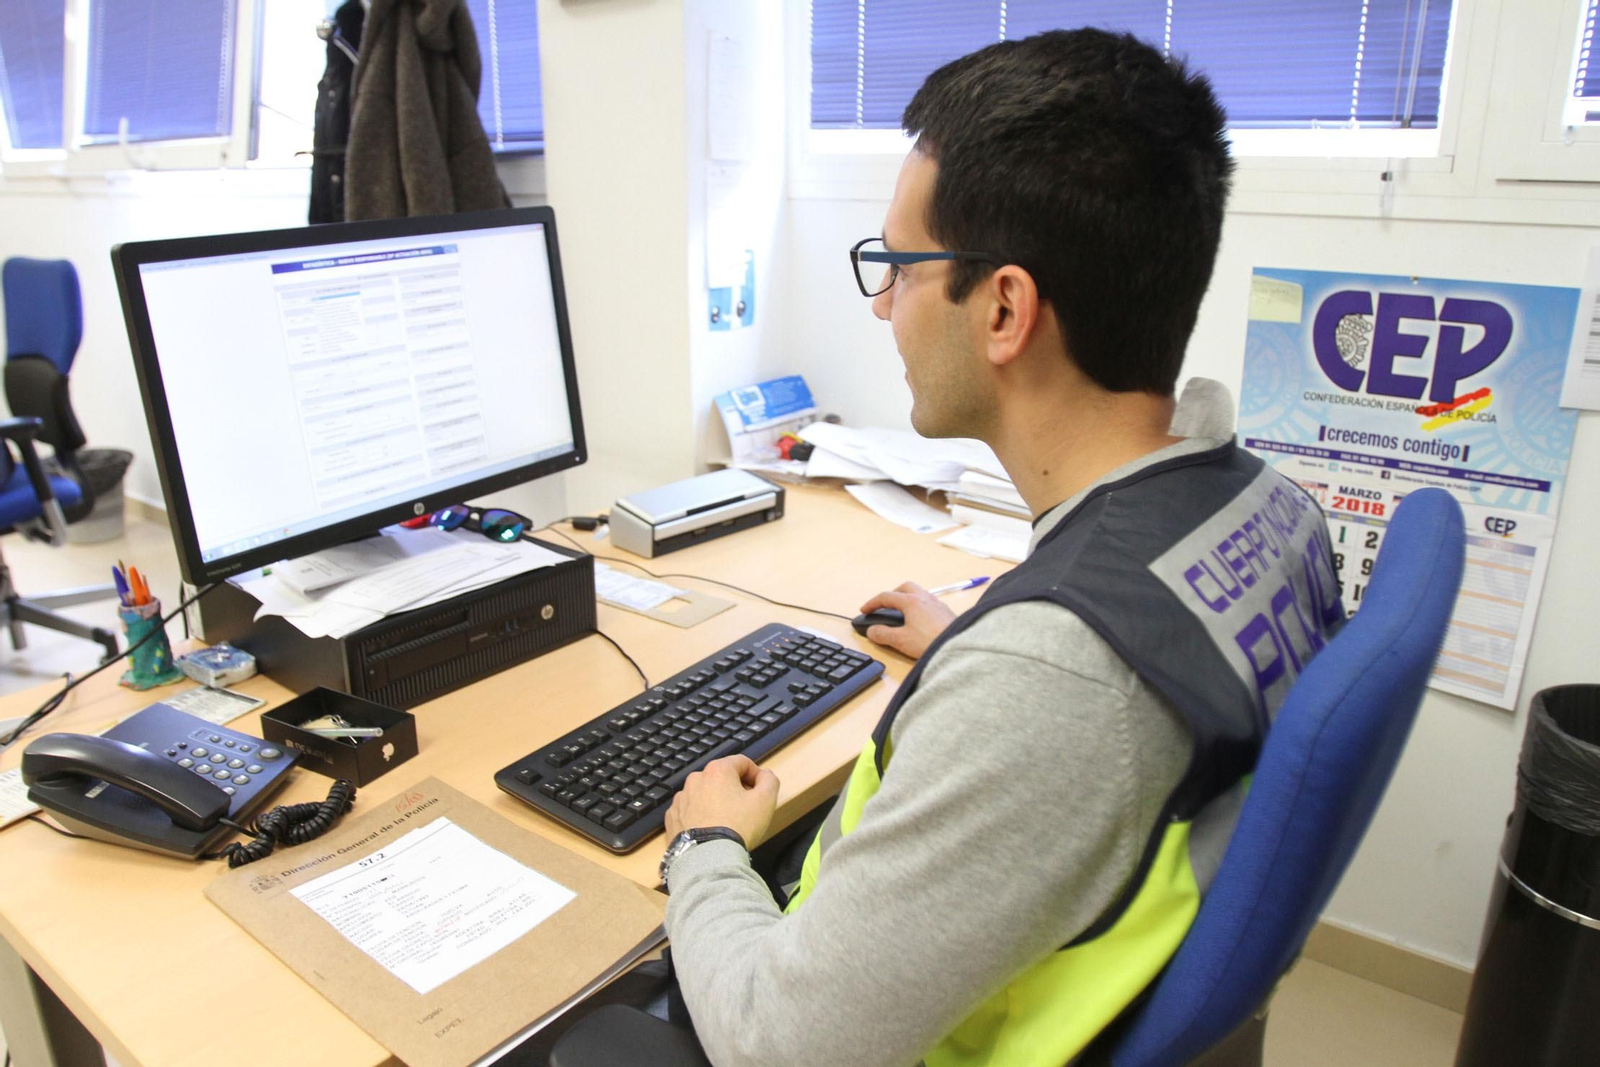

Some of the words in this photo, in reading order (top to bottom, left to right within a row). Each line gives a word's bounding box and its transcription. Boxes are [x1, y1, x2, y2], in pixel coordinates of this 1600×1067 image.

[1313, 290, 1513, 403] CEP
[1303, 391, 1383, 409] CONFEDERACIÓN
[1456, 409, 1497, 424] POLICÍA
[1327, 427, 1399, 450] crecemos
[1402, 438, 1460, 461] contigo
[1338, 485, 1383, 501] MARZO
[1331, 496, 1385, 516] 2018
[1485, 516, 1517, 535] CEP
[1338, 526, 1346, 543] 1
[1364, 531, 1379, 550] 2
[1361, 558, 1374, 576] 9
[280, 852, 336, 878] Dirección
[337, 832, 378, 855] General
[380, 822, 394, 834] de
[394, 816, 405, 826] la
[359, 853, 386, 868] 57.2
